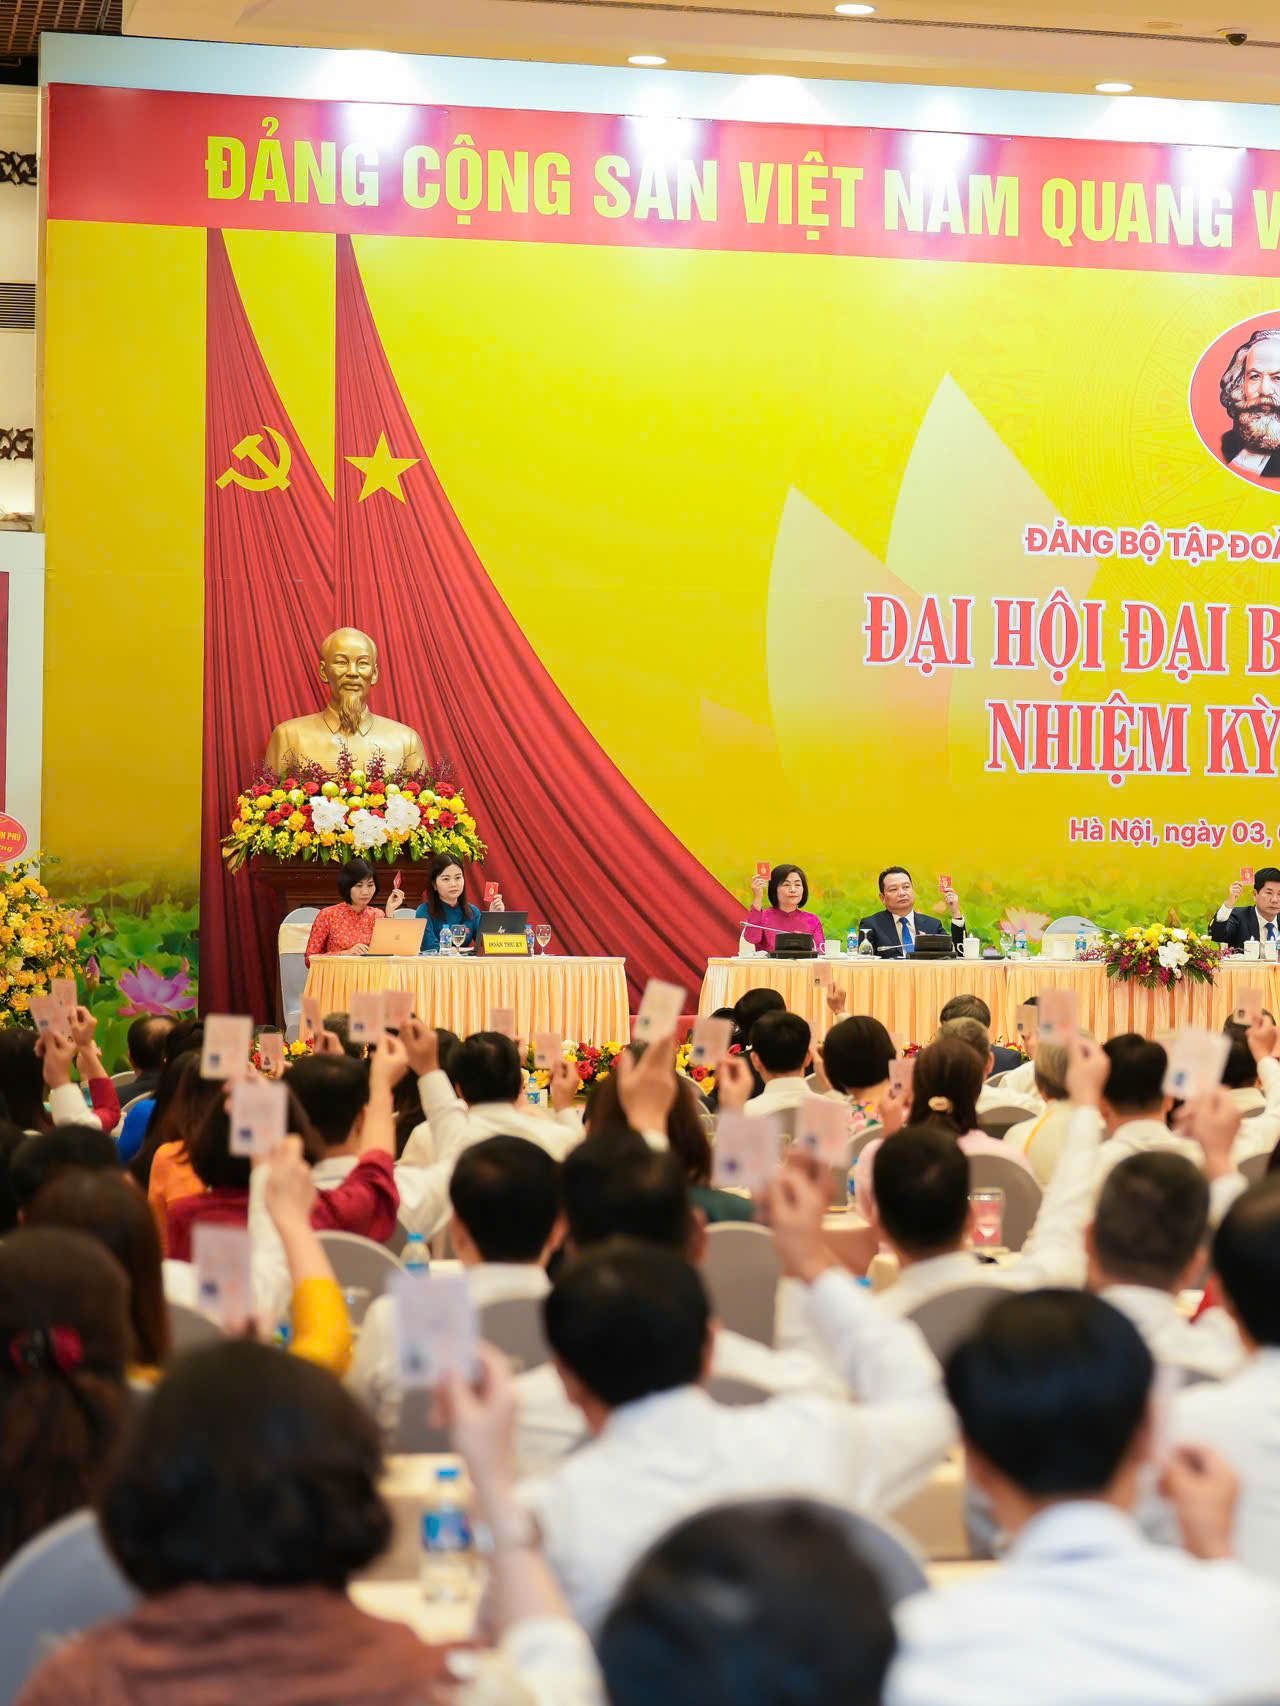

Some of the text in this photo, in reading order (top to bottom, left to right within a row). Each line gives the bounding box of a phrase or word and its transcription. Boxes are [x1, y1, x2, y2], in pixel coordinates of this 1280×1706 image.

[204, 116, 379, 207] ĐẢNG
[402, 133, 571, 226] CỘNG
[738, 150, 864, 241] VIỆT
[883, 168, 1020, 237] NAM
[1041, 177, 1234, 248] QUANG
[1024, 519, 1115, 555] ĐẢNG
[1119, 523, 1162, 563] BỘ
[1166, 525, 1225, 565] TẬP
[863, 594, 974, 675] ĐẠI
[992, 588, 1104, 683] HỘI
[1121, 602, 1229, 681] ĐẠI
[986, 691, 1190, 786] NHIỆM
[1070, 817, 1103, 841] Hà
[1110, 818, 1158, 847] Nội,
[1164, 820, 1226, 848] ngày
[1232, 822, 1272, 848] 03,
